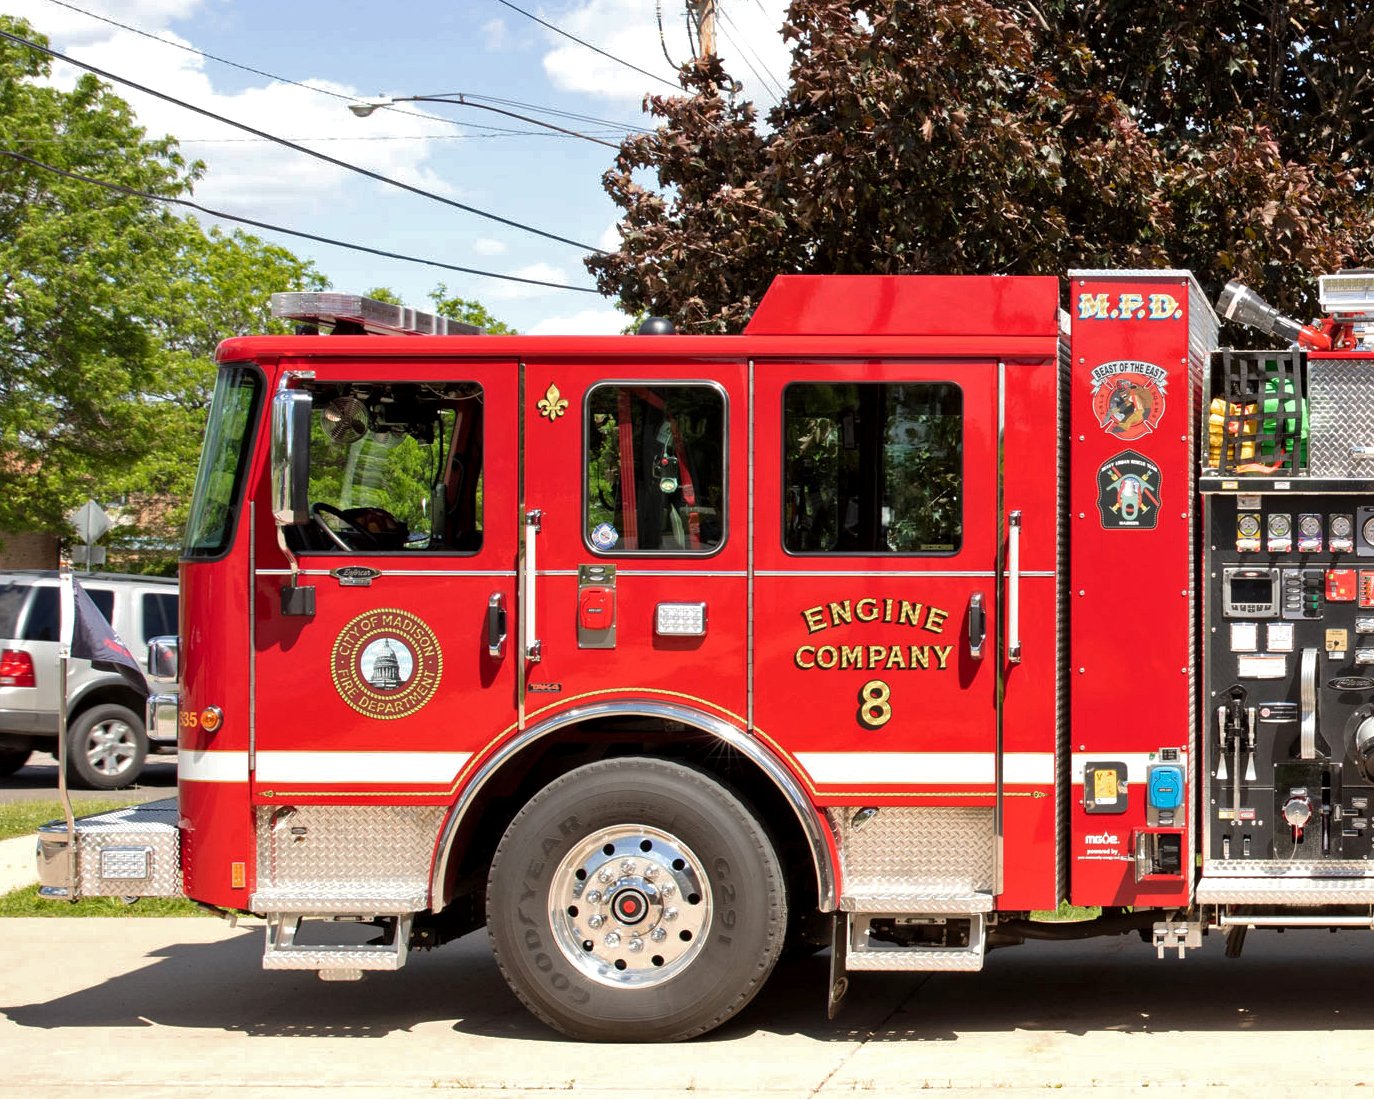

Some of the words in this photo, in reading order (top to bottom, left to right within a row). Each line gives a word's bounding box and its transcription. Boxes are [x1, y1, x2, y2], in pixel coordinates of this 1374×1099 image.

[1078, 293, 1183, 320] M.F.D.
[1094, 363, 1118, 379] BEAST
[1119, 362, 1130, 372] OF
[1131, 363, 1145, 373] THE
[1145, 365, 1165, 379] EAST
[801, 597, 949, 634] ENGINE
[339, 626, 361, 656] CITY
[360, 615, 378, 631] OF
[382, 615, 435, 657] MADISON
[794, 645, 954, 671] COMPANY
[338, 669, 358, 698] FIRE
[358, 670, 435, 713] DEPARTMENT
[856, 679, 892, 731] 8
[518, 815, 591, 1007] GOODYEAR
